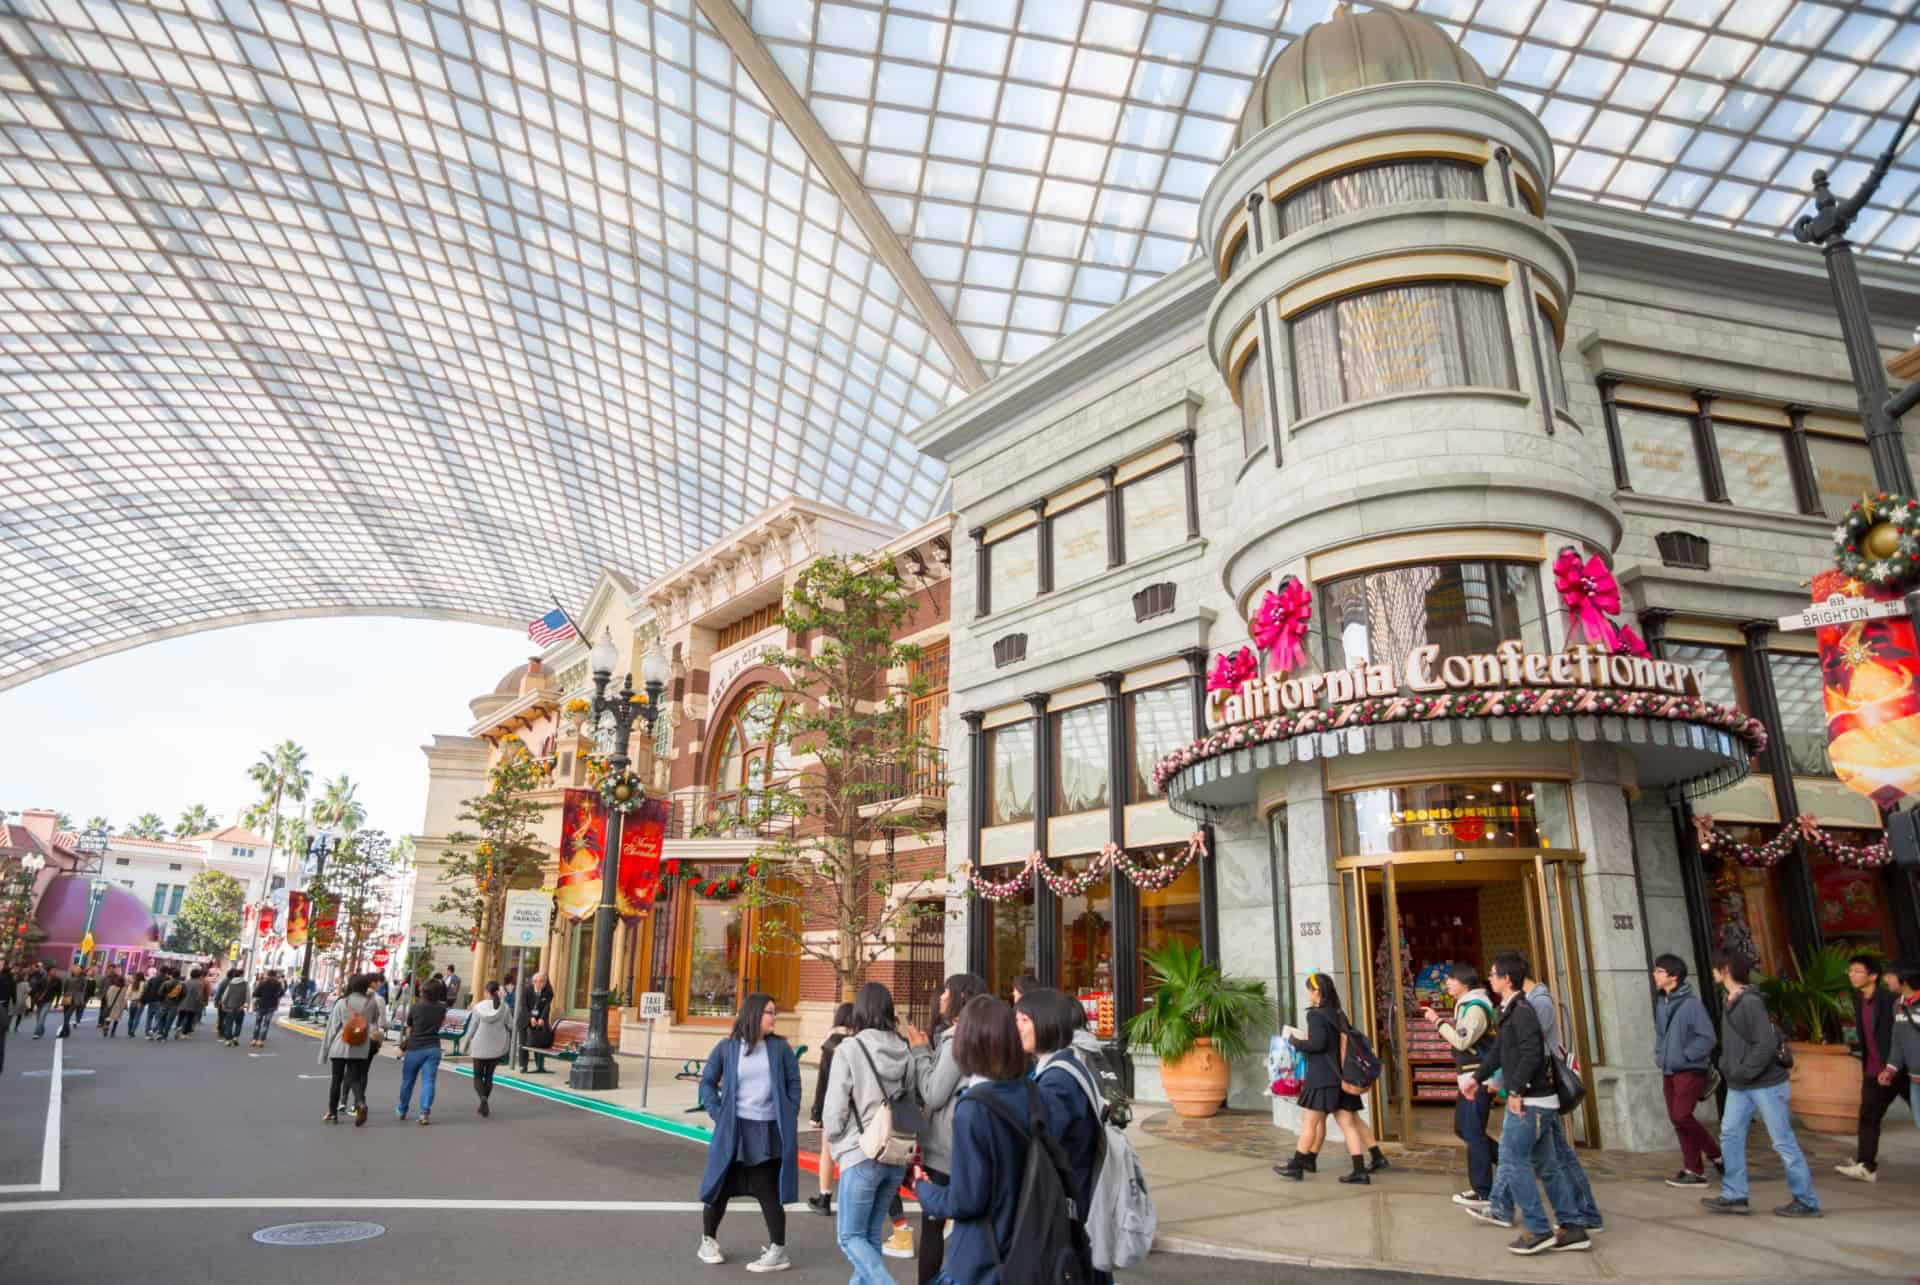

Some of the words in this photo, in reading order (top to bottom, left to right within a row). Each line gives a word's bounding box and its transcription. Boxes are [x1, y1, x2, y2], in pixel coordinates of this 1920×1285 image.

[1803, 607, 1869, 625] BRIGHTON
[1204, 657, 1398, 730] California
[1407, 640, 1707, 696] Confectionery
[513, 915, 543, 923] PARKING
[646, 996, 661, 1005] TAXI
[643, 1005, 662, 1014] ZONE
